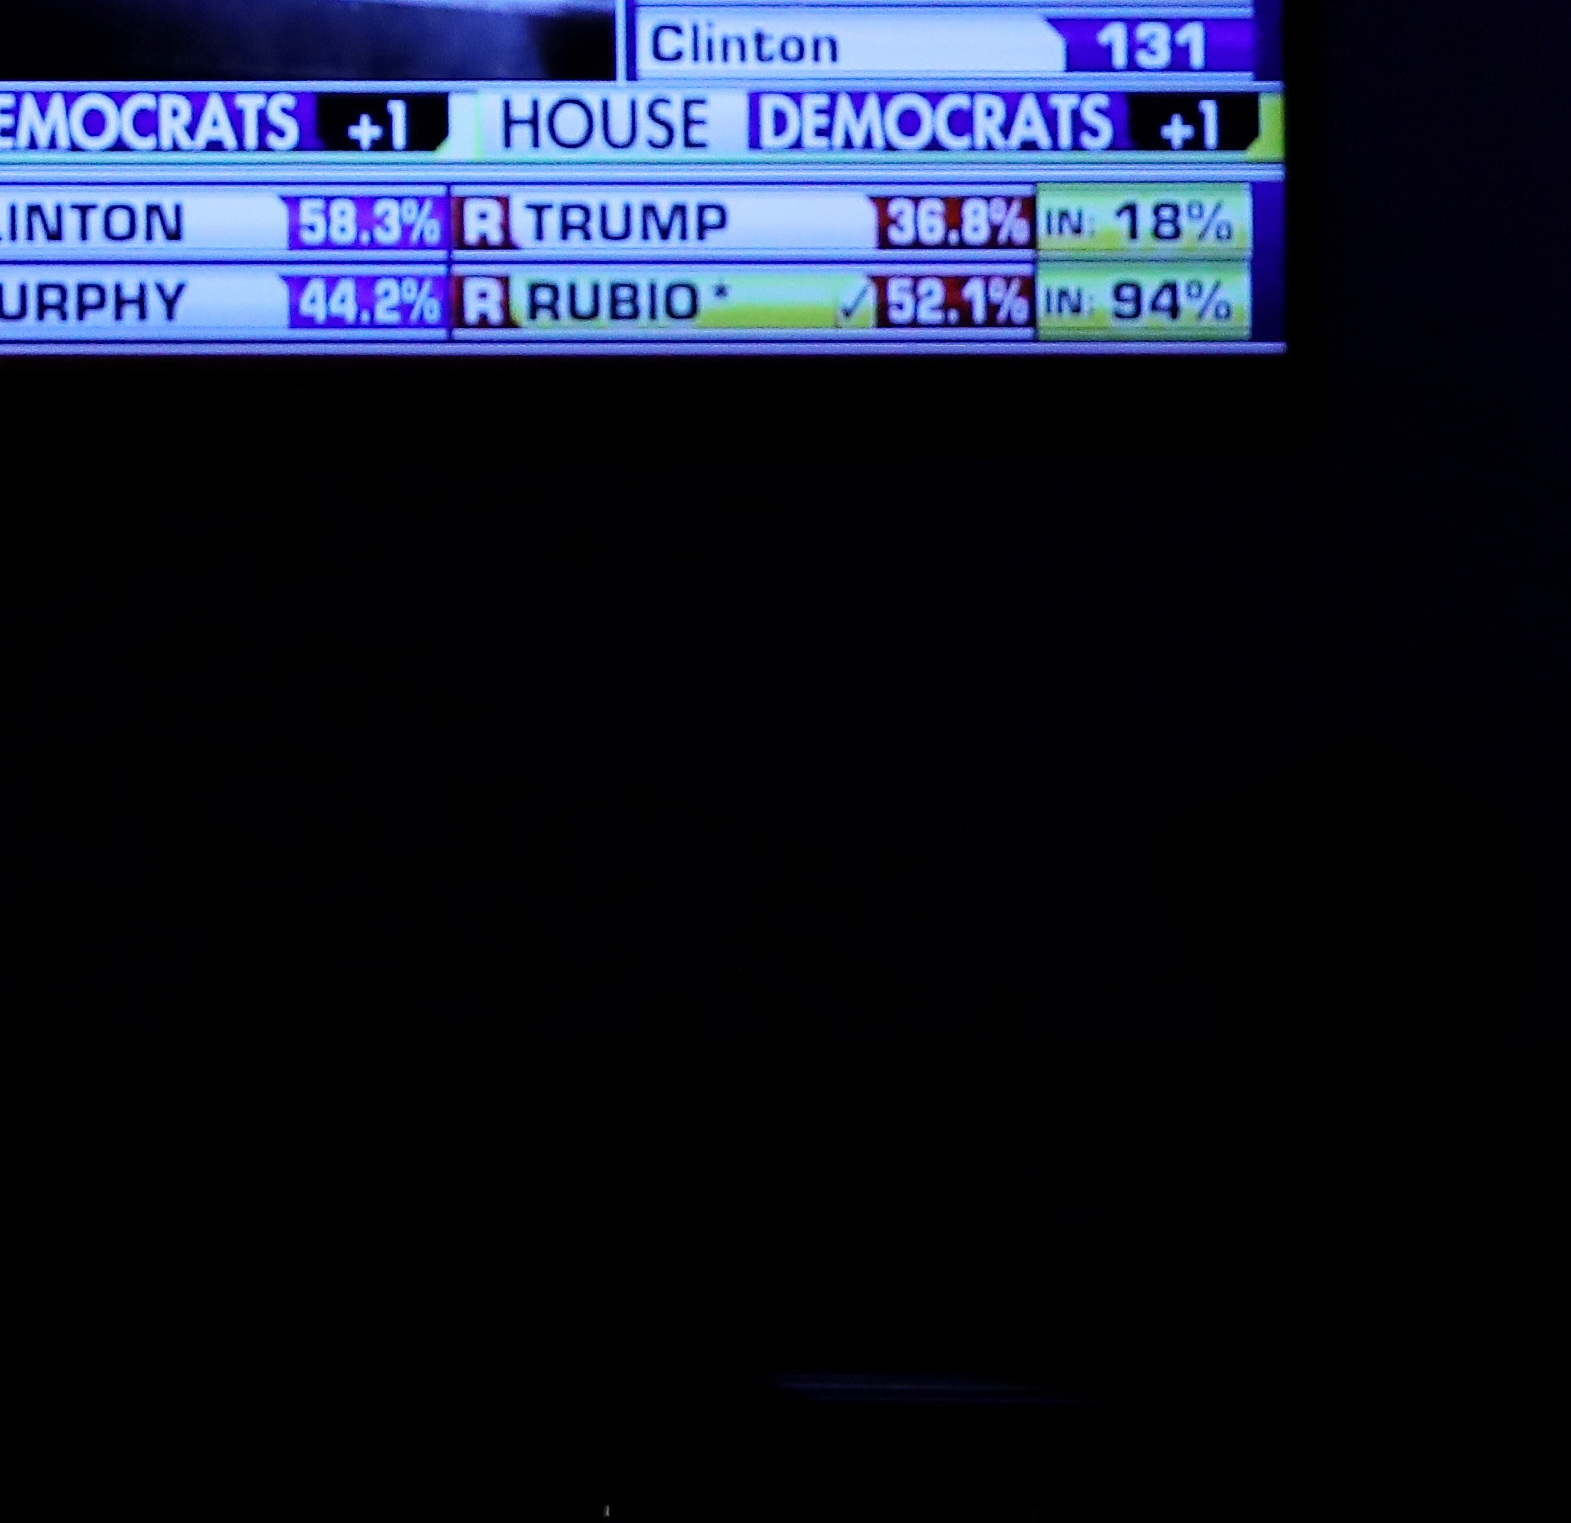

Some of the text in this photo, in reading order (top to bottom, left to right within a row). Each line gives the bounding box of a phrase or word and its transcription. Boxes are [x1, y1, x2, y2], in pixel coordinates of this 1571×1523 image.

[651, 19, 1206, 68] Clinton 131
[347, 98, 410, 150] +1
[503, 93, 1219, 152] HOUSE DEMOCRATS +1
[298, 197, 440, 246] 58.3%
[463, 197, 504, 244] R
[526, 202, 727, 242] TRUMP
[886, 197, 1030, 244] 36.8%
[1116, 201, 1233, 242] 18%
[298, 278, 441, 326] 44.2%
[463, 278, 504, 325] R
[886, 277, 1030, 325] 52.1%
[1113, 280, 1232, 321] 94%
